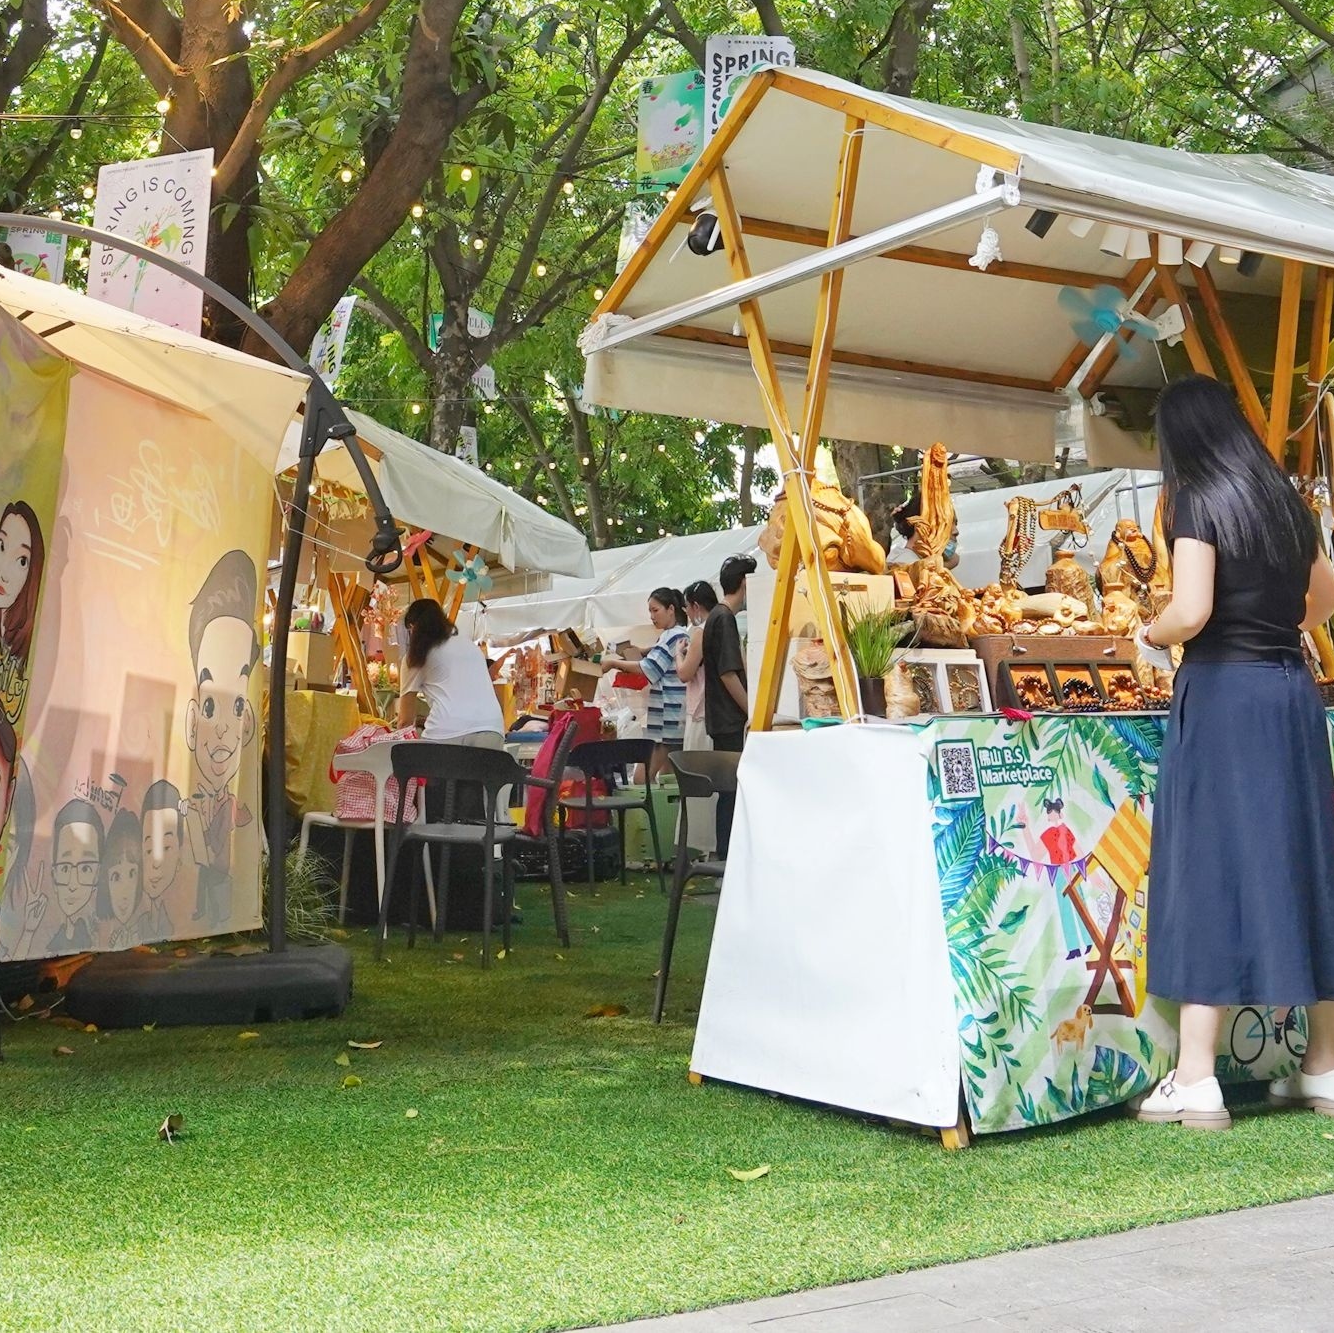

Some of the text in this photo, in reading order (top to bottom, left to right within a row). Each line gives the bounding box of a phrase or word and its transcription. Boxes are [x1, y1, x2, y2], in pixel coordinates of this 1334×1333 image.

[712, 49, 791, 75] SPRING
[142, 177, 159, 194] IS
[163, 179, 196, 255] COMING
[980, 765, 1053, 785] Marketplace
